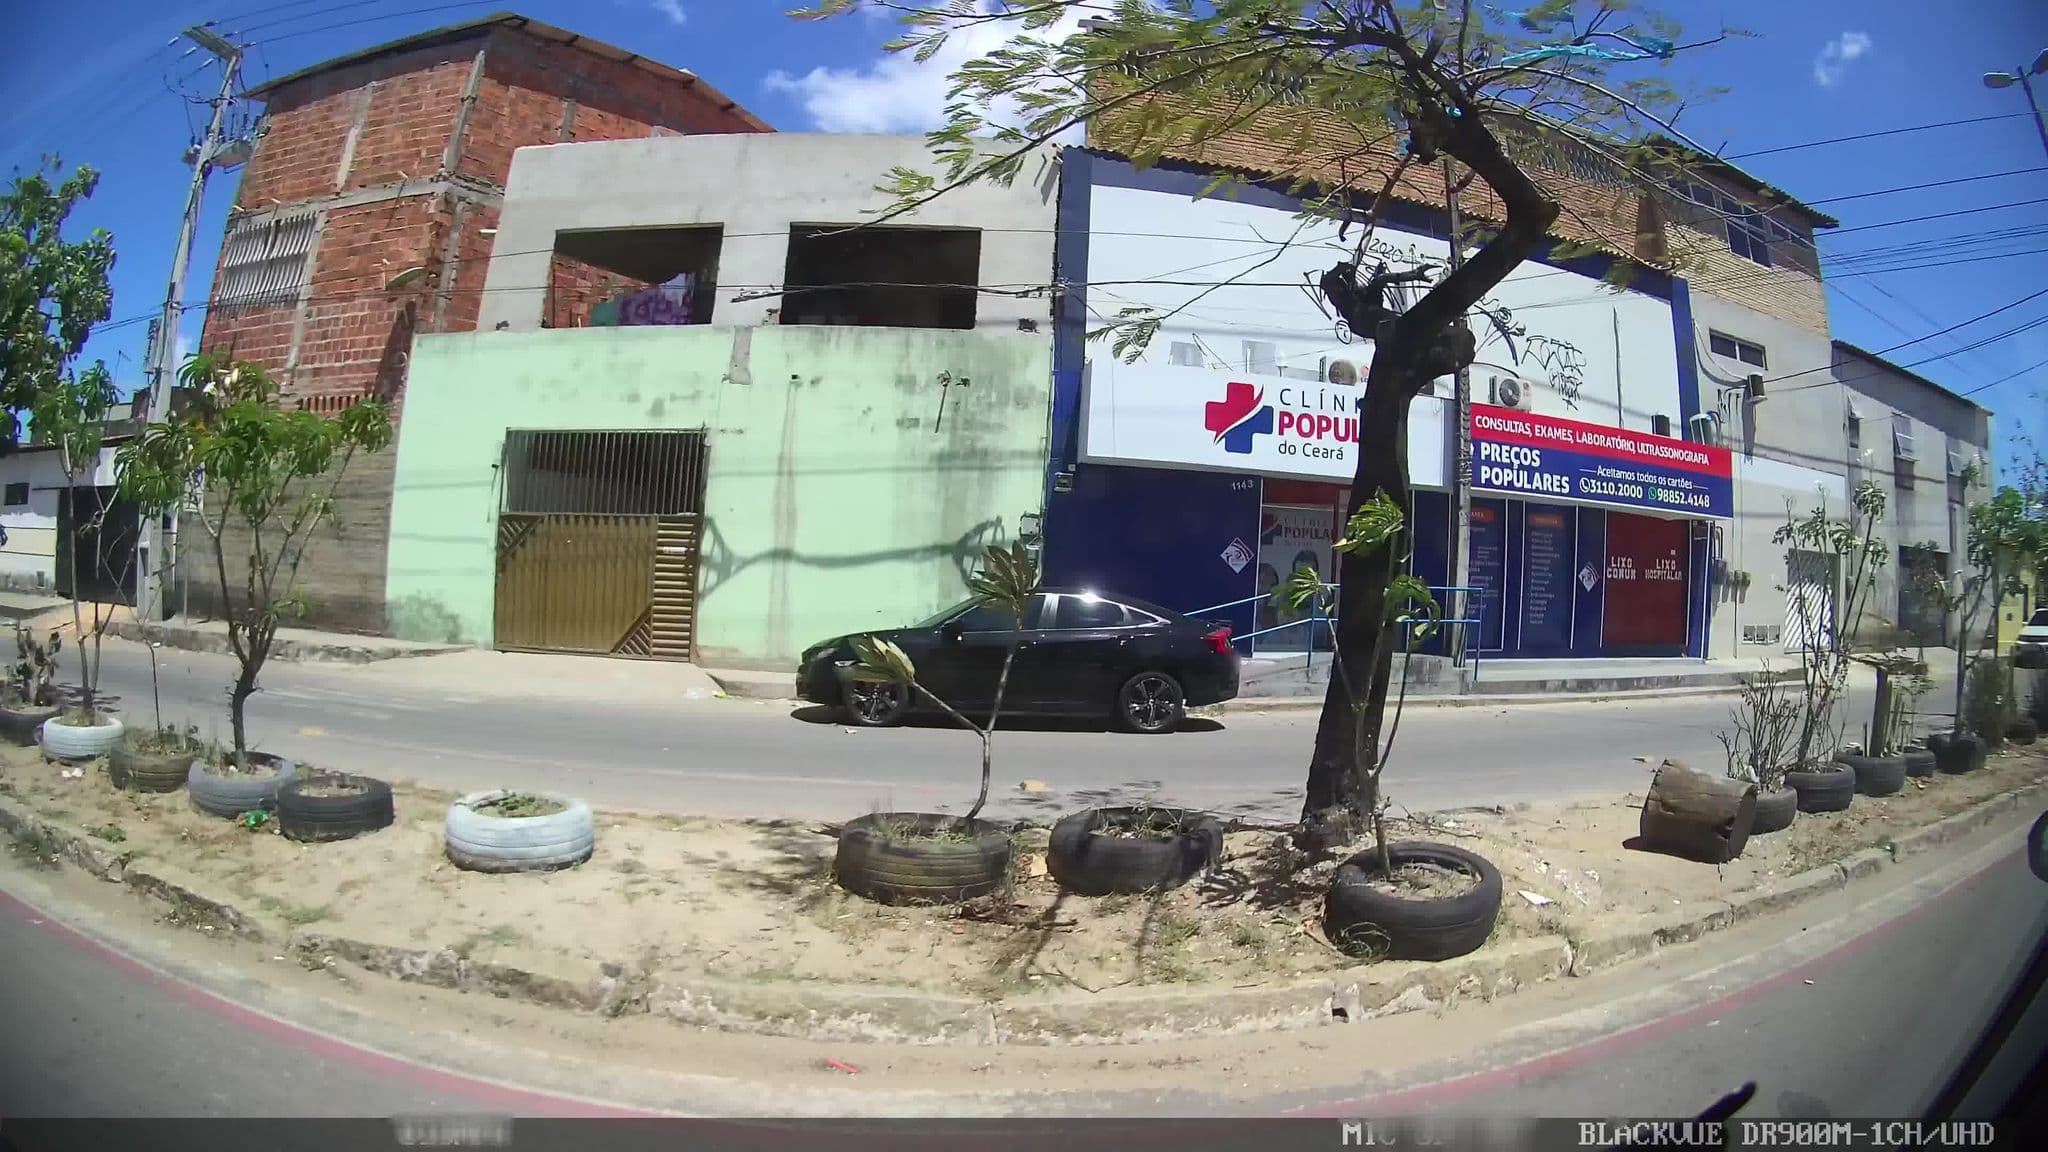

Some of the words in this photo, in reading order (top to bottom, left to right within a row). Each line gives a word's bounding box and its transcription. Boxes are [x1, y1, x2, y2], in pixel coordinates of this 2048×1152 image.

[1279, 388, 1358, 414] CLÍNI
[1278, 410, 1360, 443] POPUL
[1278, 440, 1296, 455] do
[1302, 442, 1344, 460] Ceará
[1475, 415, 1533, 438] CONSULTAS,
[1534, 424, 1574, 444] EXAMES,
[1576, 431, 1636, 455] LABORATÓRIO,
[1637, 444, 1710, 466] ULTRASSONOGRAFIA
[1480, 441, 1541, 469] PREÇOS
[1480, 465, 1570, 494] POPULARES
[1597, 465, 1635, 481] Aceitamos
[1636, 471, 1657, 484] todos
[1658, 476, 1667, 486] os
[1667, 476, 1693, 490] cartões
[1590, 479, 1643, 499] 3110.2000
[1657, 488, 1710, 508] 98852.4148
[1606, 567, 1636, 580] COMUM
[1611, 556, 1633, 569] LIXO
[1656, 558, 1676, 571] LIXO
